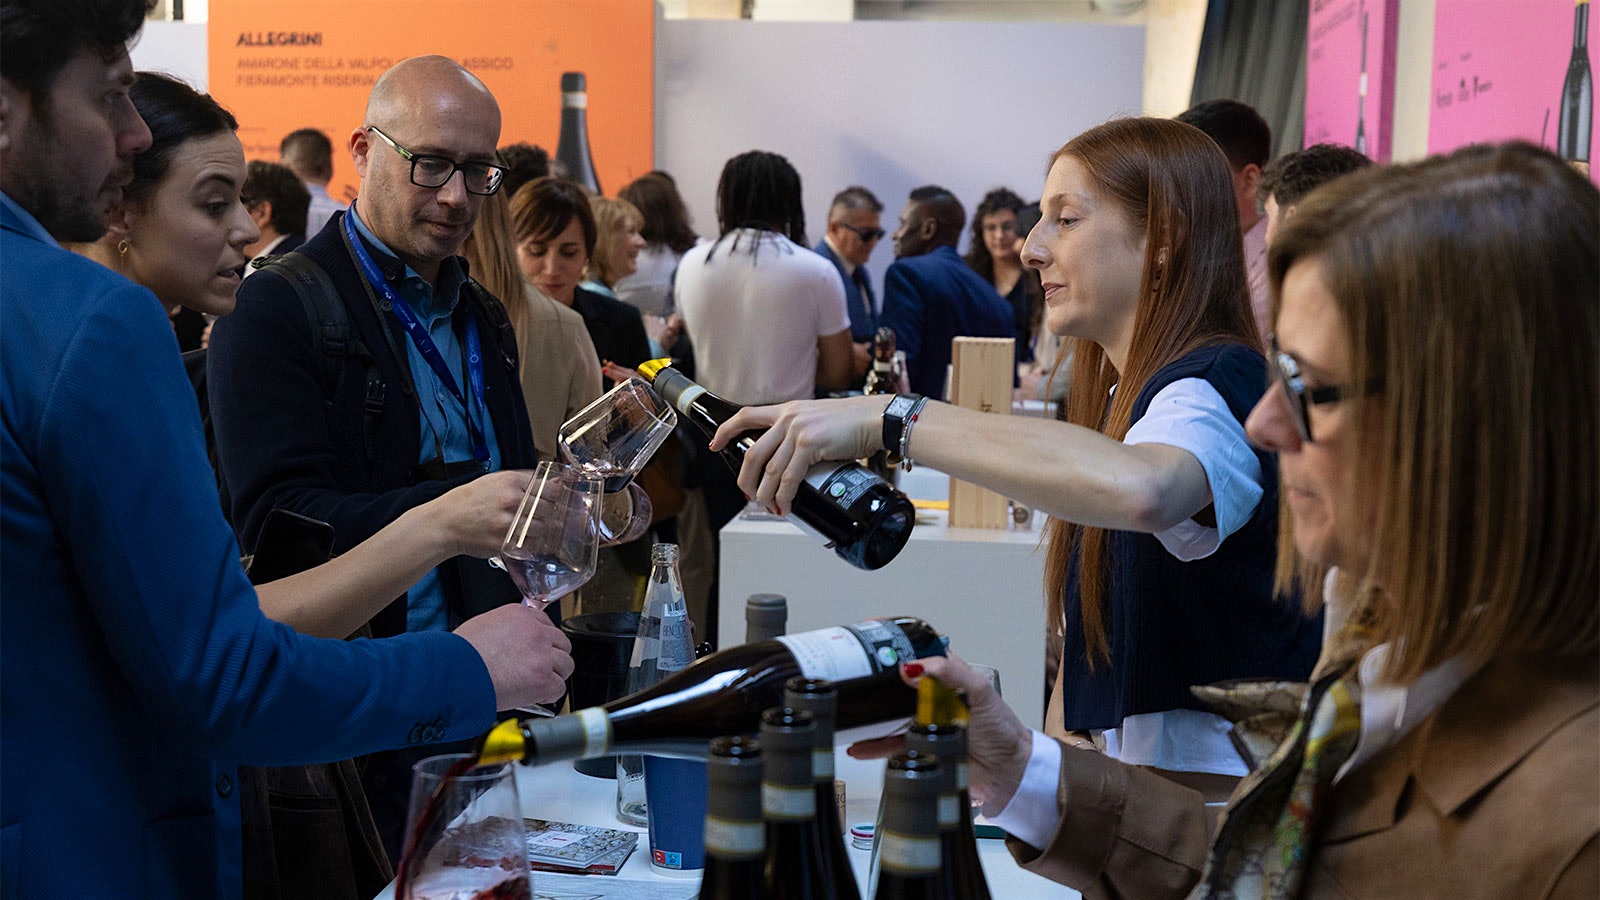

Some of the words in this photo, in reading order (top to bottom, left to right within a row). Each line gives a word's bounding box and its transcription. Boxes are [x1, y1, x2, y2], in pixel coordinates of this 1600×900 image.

[237, 32, 322, 46] ALLEGRINI
[237, 58, 300, 69] AMARONE
[305, 58, 344, 69] DELLA
[349, 58, 396, 69] VALPOL
[463, 57, 513, 69] ASSICO
[237, 74, 318, 86] FIERAMONTE
